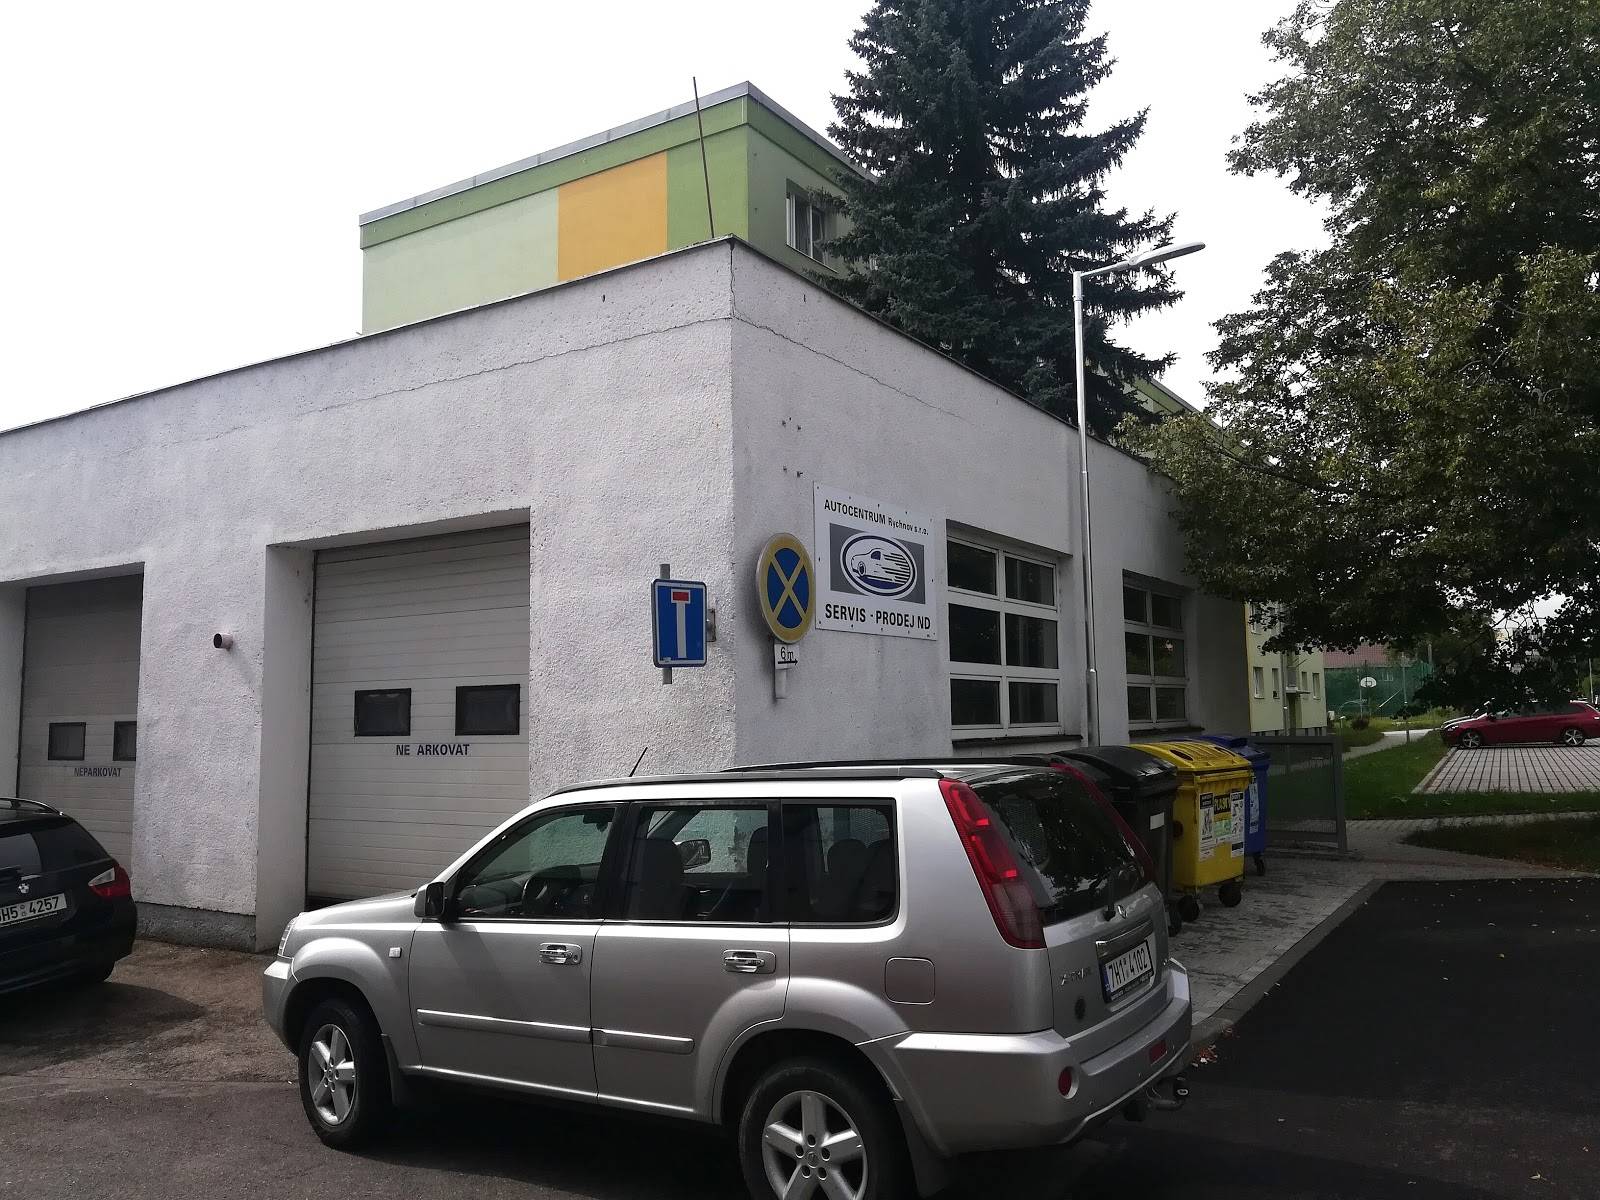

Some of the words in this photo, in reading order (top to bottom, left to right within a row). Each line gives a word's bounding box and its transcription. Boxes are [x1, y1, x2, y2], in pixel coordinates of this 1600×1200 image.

[824, 499, 886, 525] AUTOCENTRUM
[888, 517, 913, 532] Rychnov
[914, 525, 929, 536] s.r.o.
[825, 603, 866, 623] SERVIS
[876, 610, 915, 628] PRODEJ
[917, 615, 931, 630] ND
[396, 744, 410, 756] NE
[417, 743, 470, 756] ARKOVAT
[74, 767, 122, 777] NEPARKOVAT
[0, 906, 18, 922] H5
[29, 896, 59, 914] 4257
[1128, 947, 1148, 974] 4102
